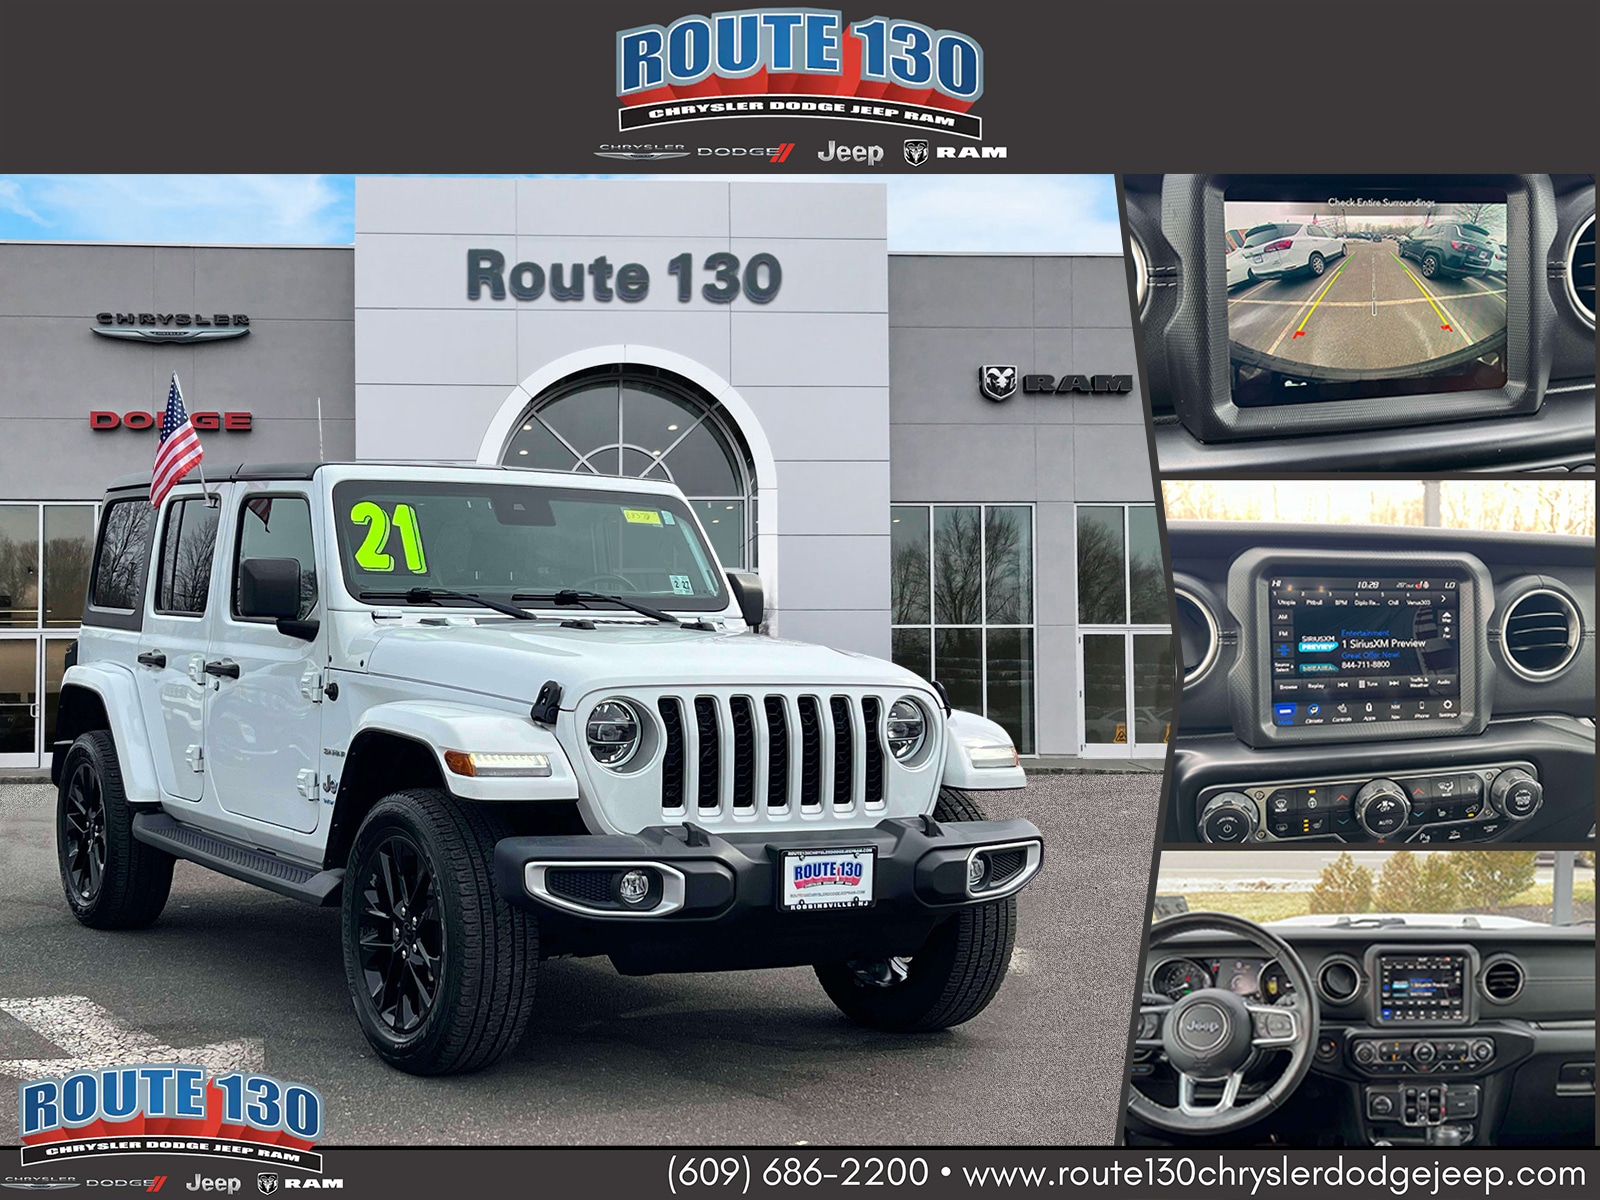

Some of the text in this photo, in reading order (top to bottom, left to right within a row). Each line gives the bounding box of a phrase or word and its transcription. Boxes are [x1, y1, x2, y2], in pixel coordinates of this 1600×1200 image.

[1328, 197, 1436, 208] Check Entire Surroundings
[467, 248, 782, 304] Route 130
[96, 312, 250, 326] CHRYSLER
[1023, 374, 1133, 394] RAM
[350, 501, 427, 574] 21
[1357, 581, 1380, 589] 10:28
[1444, 581, 1456, 589] LO
[1341, 629, 1390, 637] Entertainment
[1342, 638, 1426, 649] 1 SiriusXM Preview
[1341, 661, 1390, 669] 844-711-8800
[793, 862, 862, 880] ROUTE 130
[1186, 1020, 1219, 1032] Jeep
